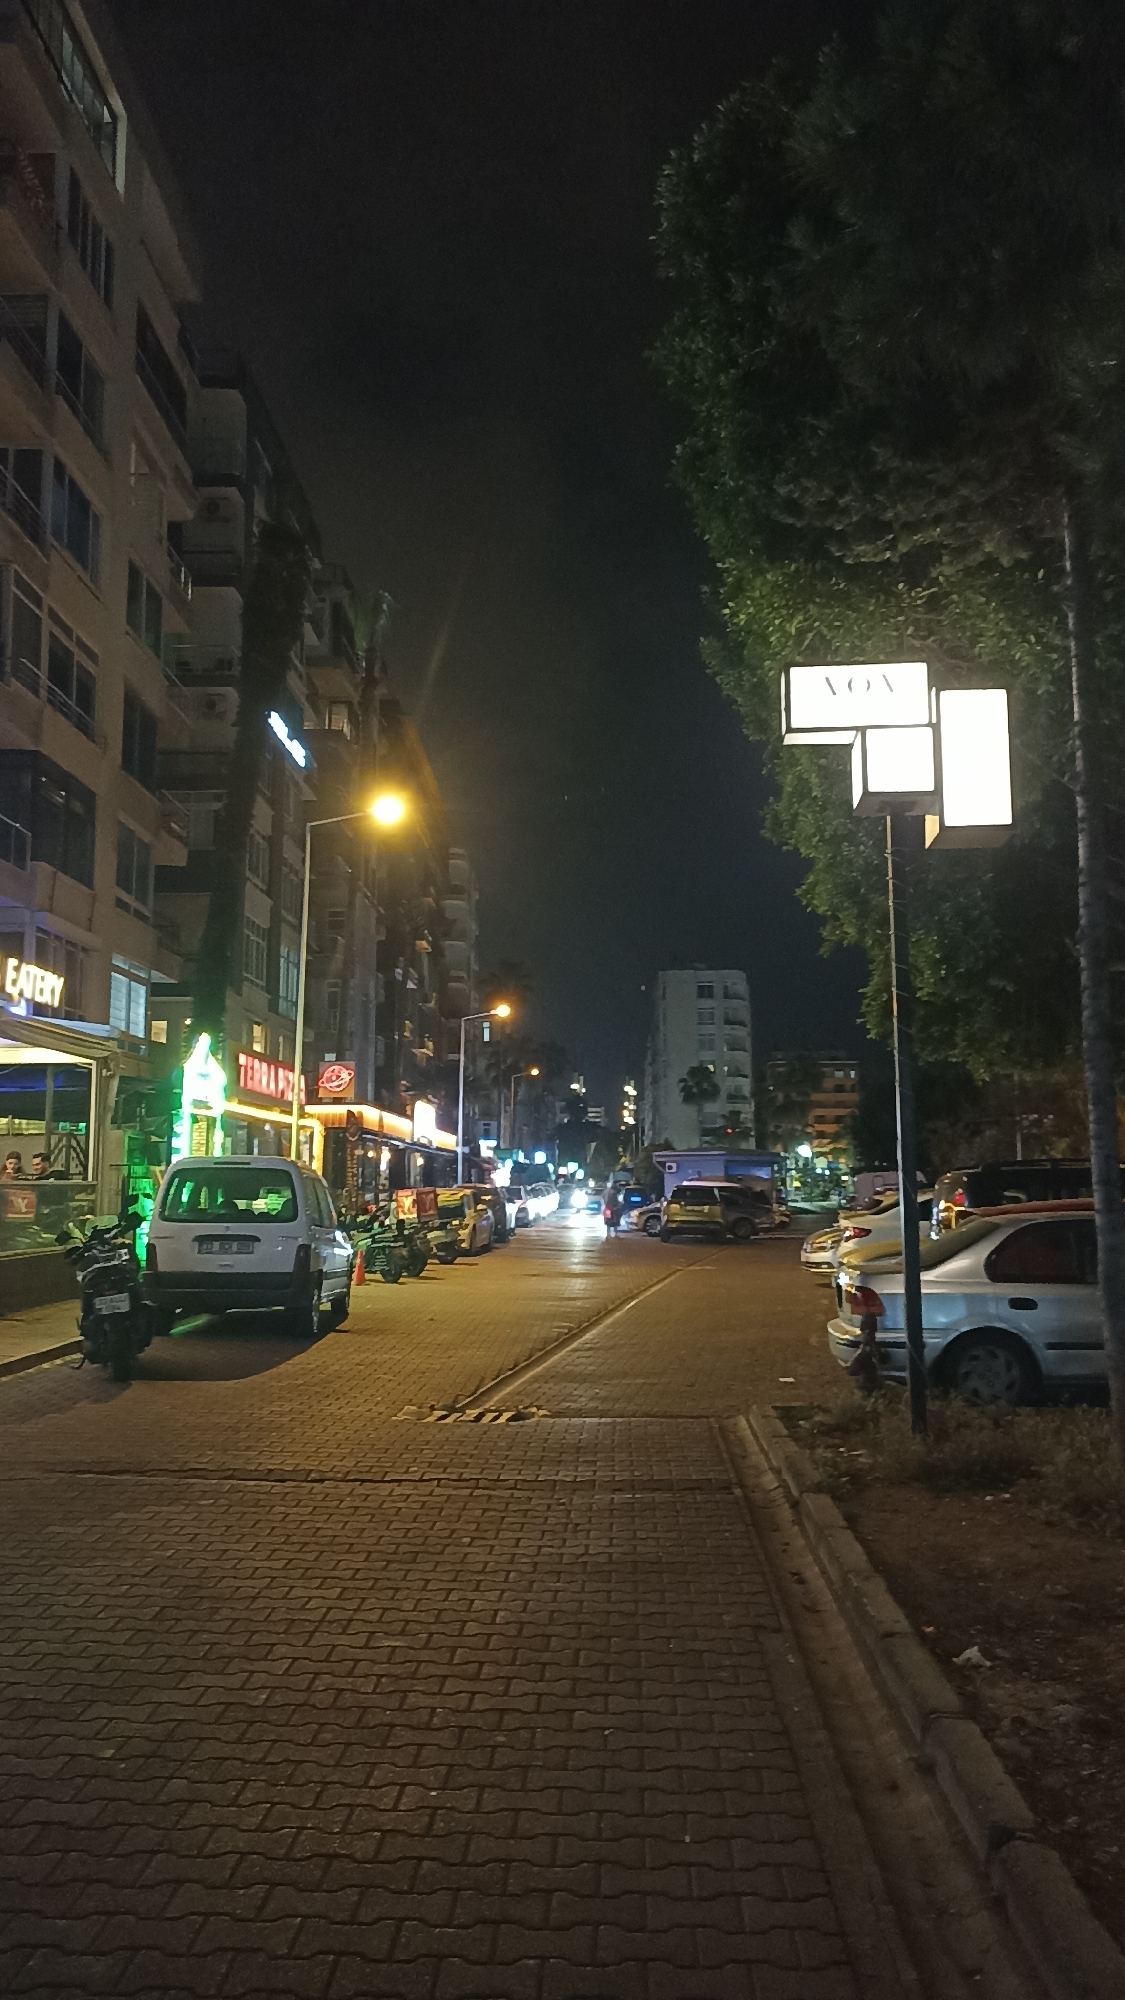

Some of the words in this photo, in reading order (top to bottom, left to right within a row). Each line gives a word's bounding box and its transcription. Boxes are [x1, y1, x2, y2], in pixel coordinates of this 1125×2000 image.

[5, 957, 65, 1008] EATERY
[239, 1052, 276, 1092] TERRA
[276, 1067, 306, 1105] PIZA
